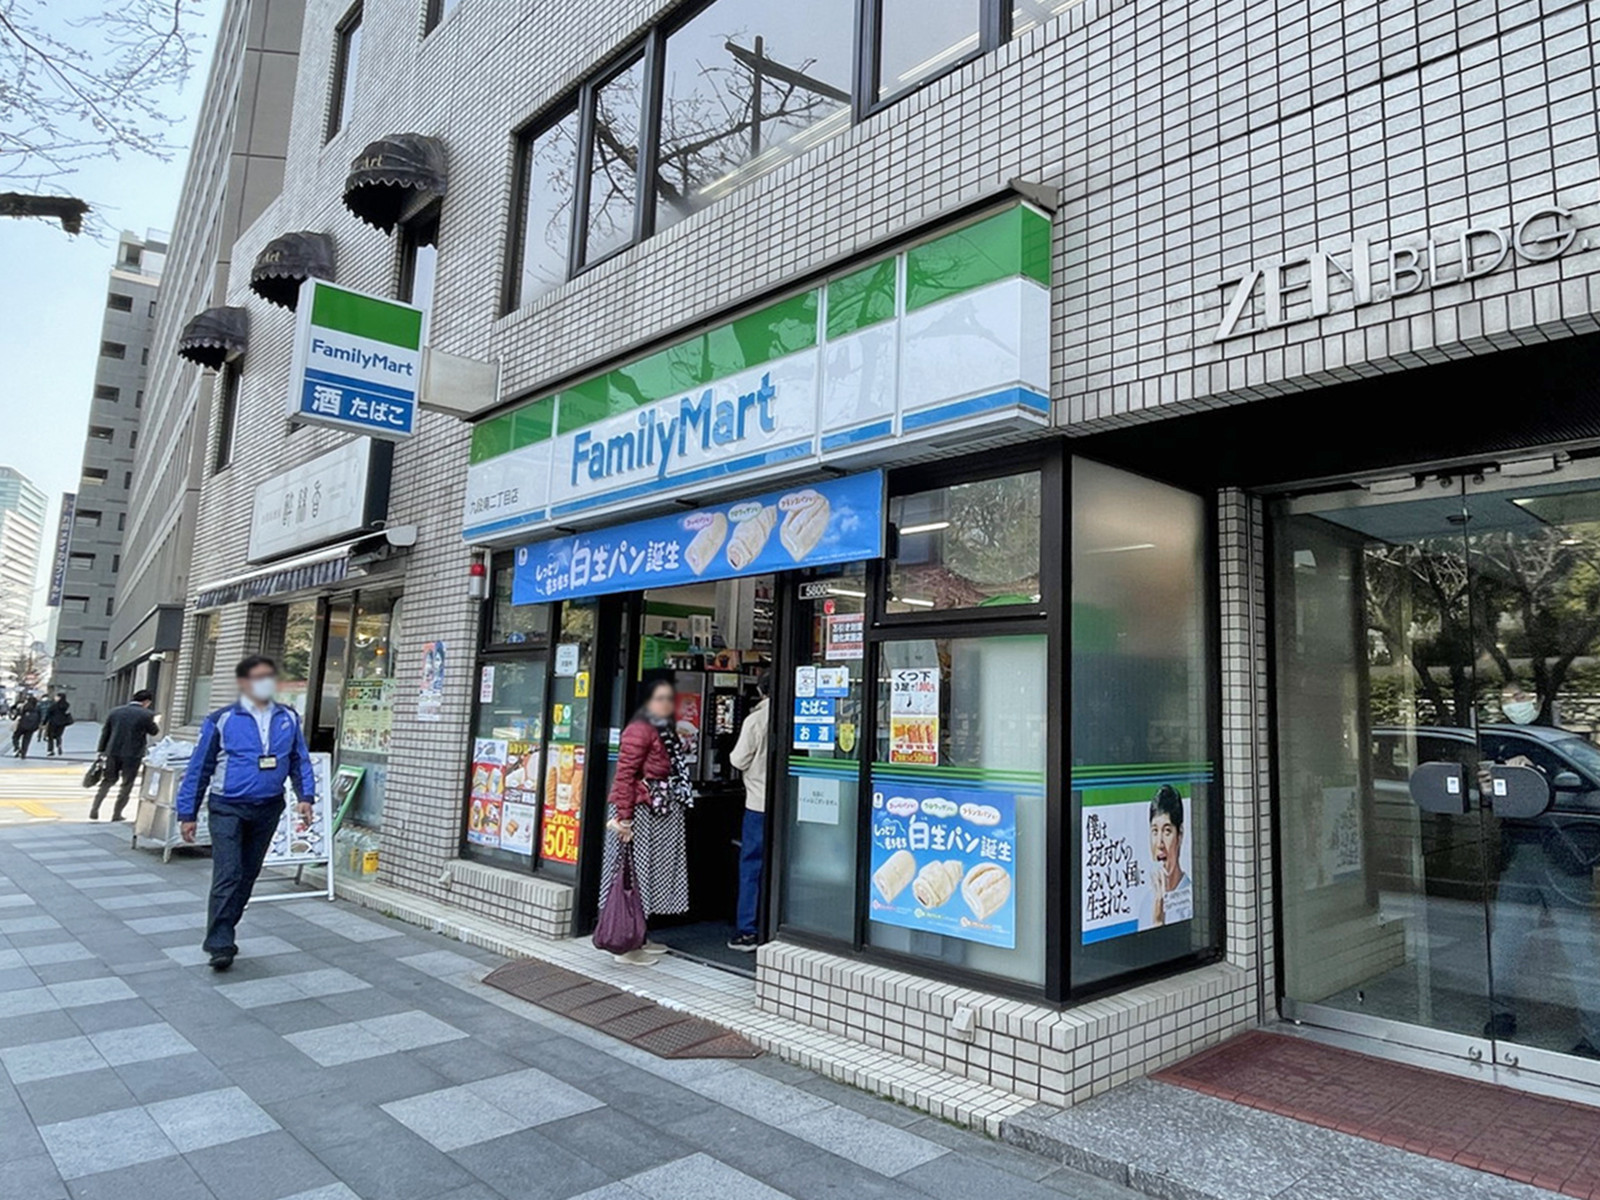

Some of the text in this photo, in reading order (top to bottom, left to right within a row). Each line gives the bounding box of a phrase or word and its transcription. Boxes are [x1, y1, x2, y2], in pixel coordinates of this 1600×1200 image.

[1213, 237, 1372, 343] ZEN
[311, 338, 414, 377] FamilyMart
[311, 385, 405, 426] 酒 たばこ
[571, 371, 777, 487] FamilyMart
[898, 671, 931, 682] くつ下
[800, 700, 829, 715] たばこ
[1086, 837, 1133, 867] おむすびの
